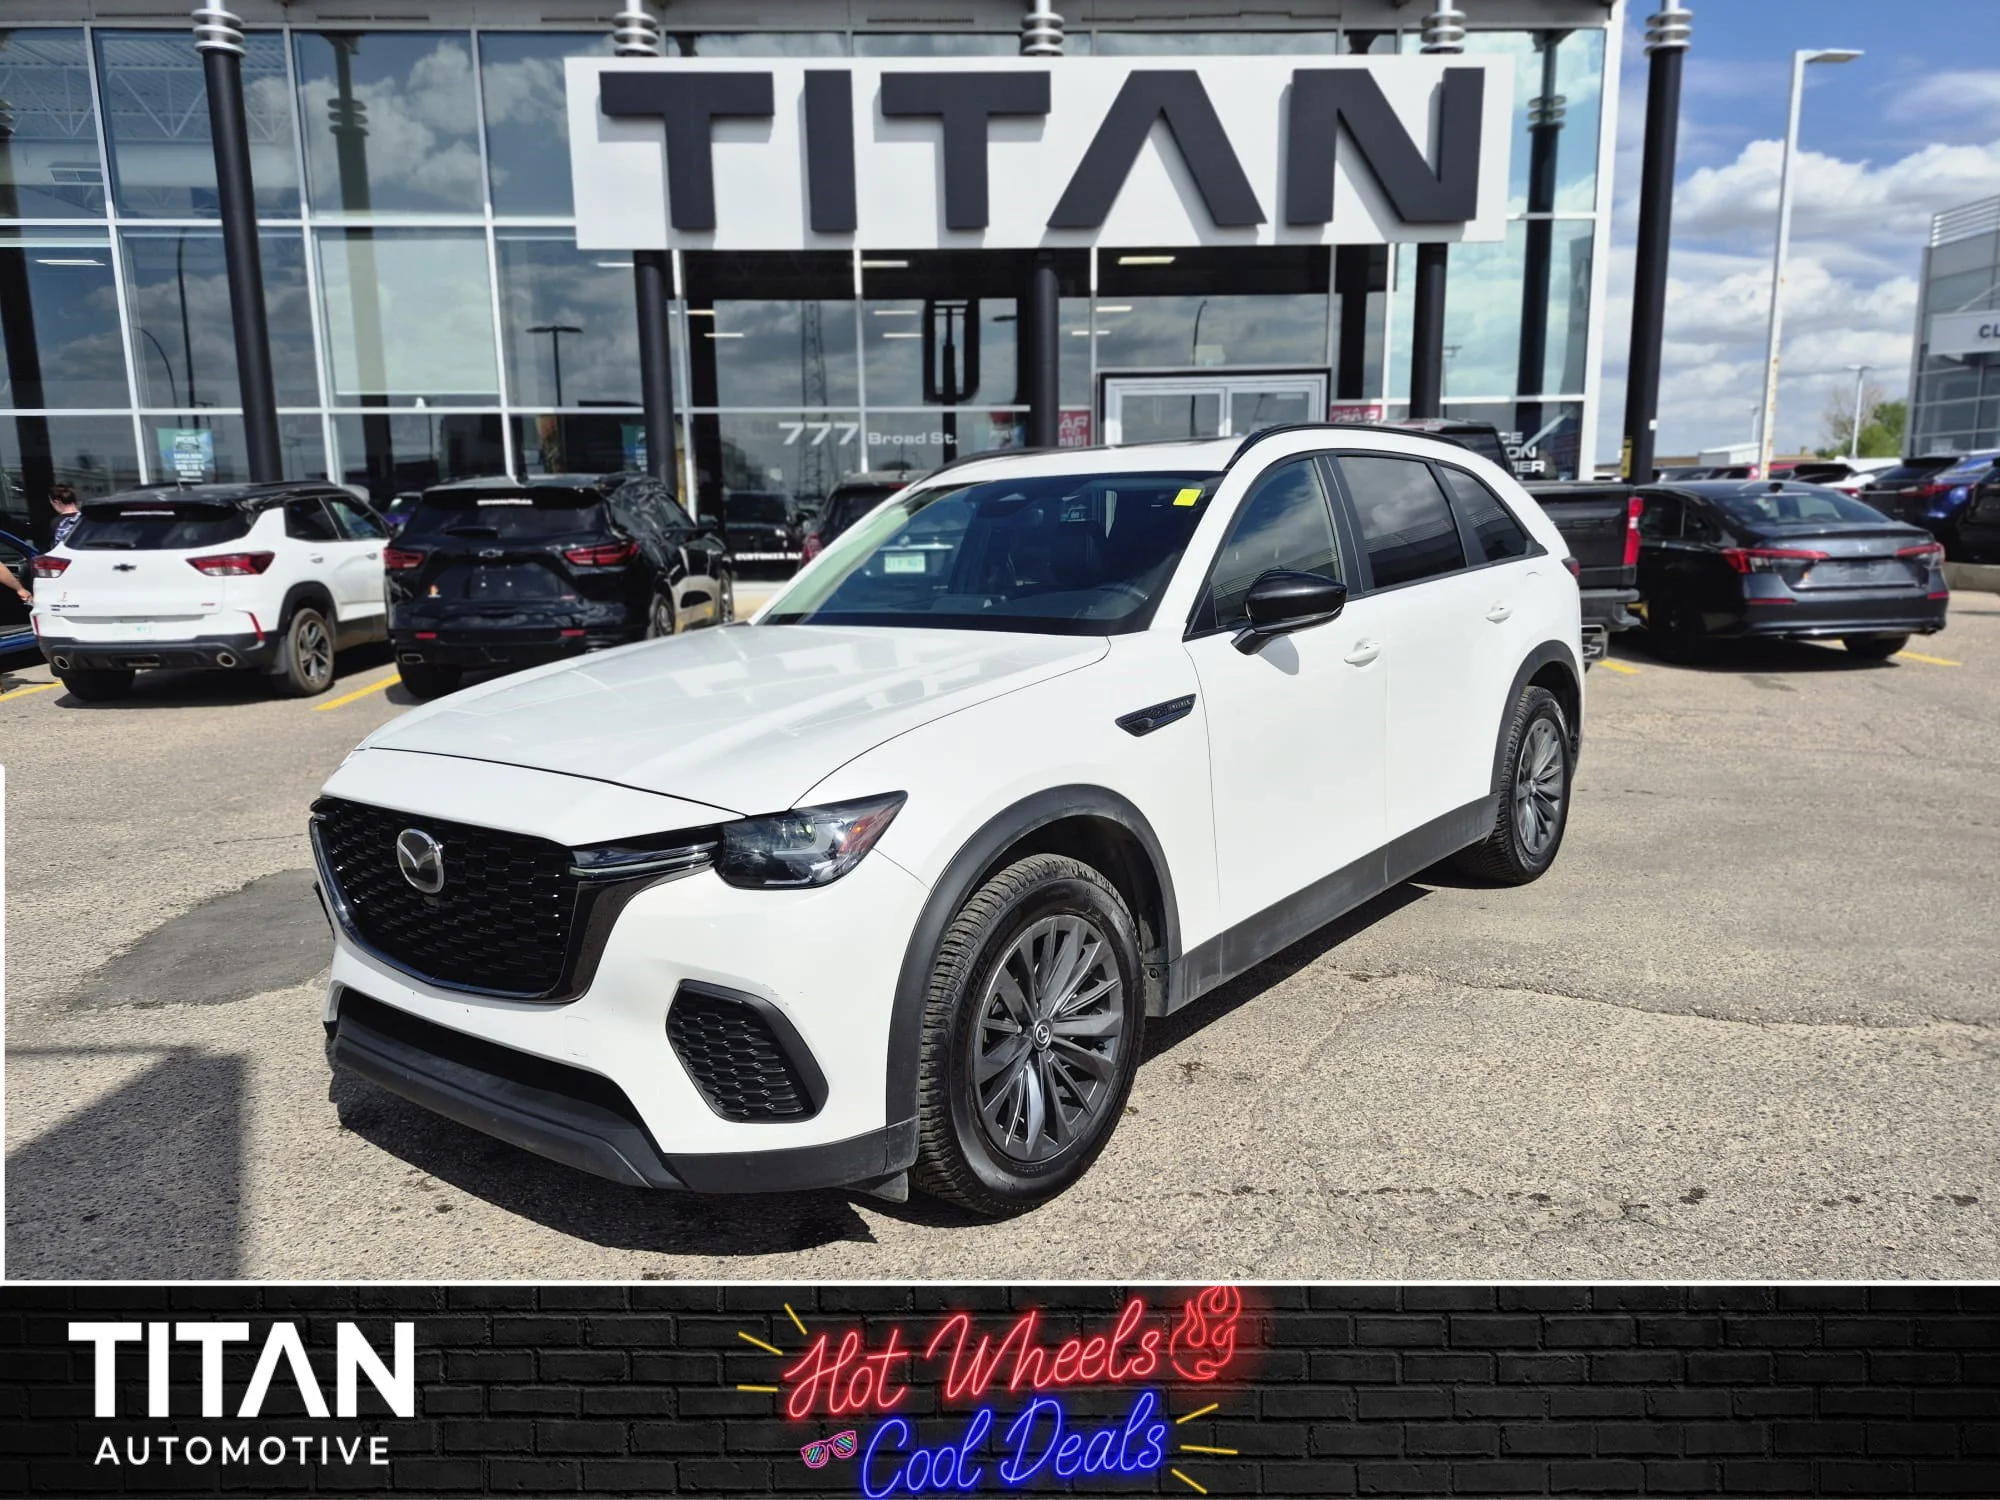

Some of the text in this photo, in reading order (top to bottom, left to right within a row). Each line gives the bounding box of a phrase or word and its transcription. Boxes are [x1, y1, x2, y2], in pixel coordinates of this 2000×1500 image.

[600, 68, 1485, 232] TITAN
[778, 421, 959, 446] 777 Broad St.
